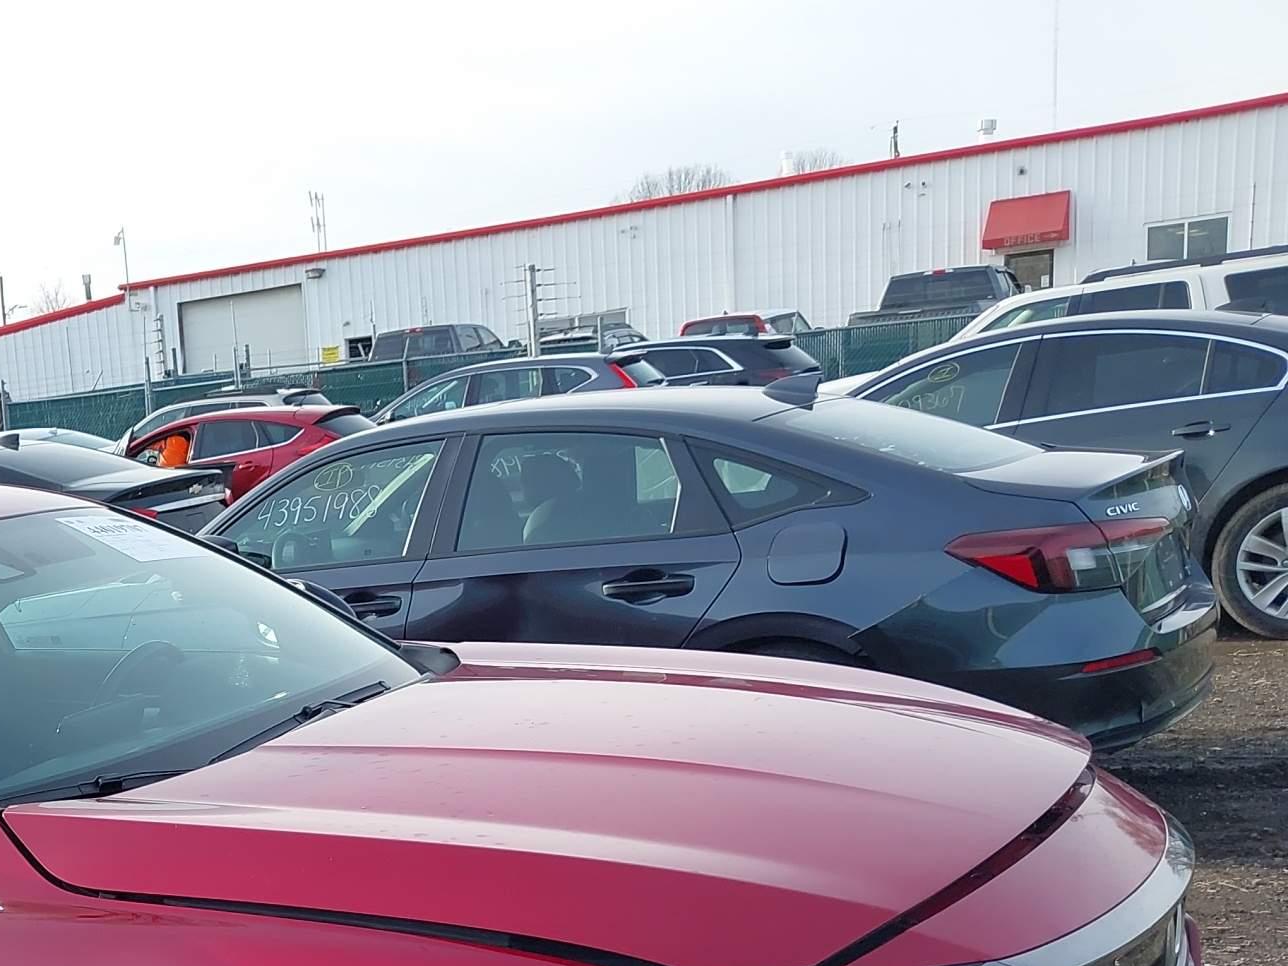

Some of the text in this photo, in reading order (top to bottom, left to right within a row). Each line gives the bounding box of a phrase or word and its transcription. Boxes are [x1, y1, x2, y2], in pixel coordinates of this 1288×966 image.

[1004, 232, 1041, 247] OFFICE
[257, 484, 383, 530] 43951988
[1106, 502, 1140, 516] CIVIC
